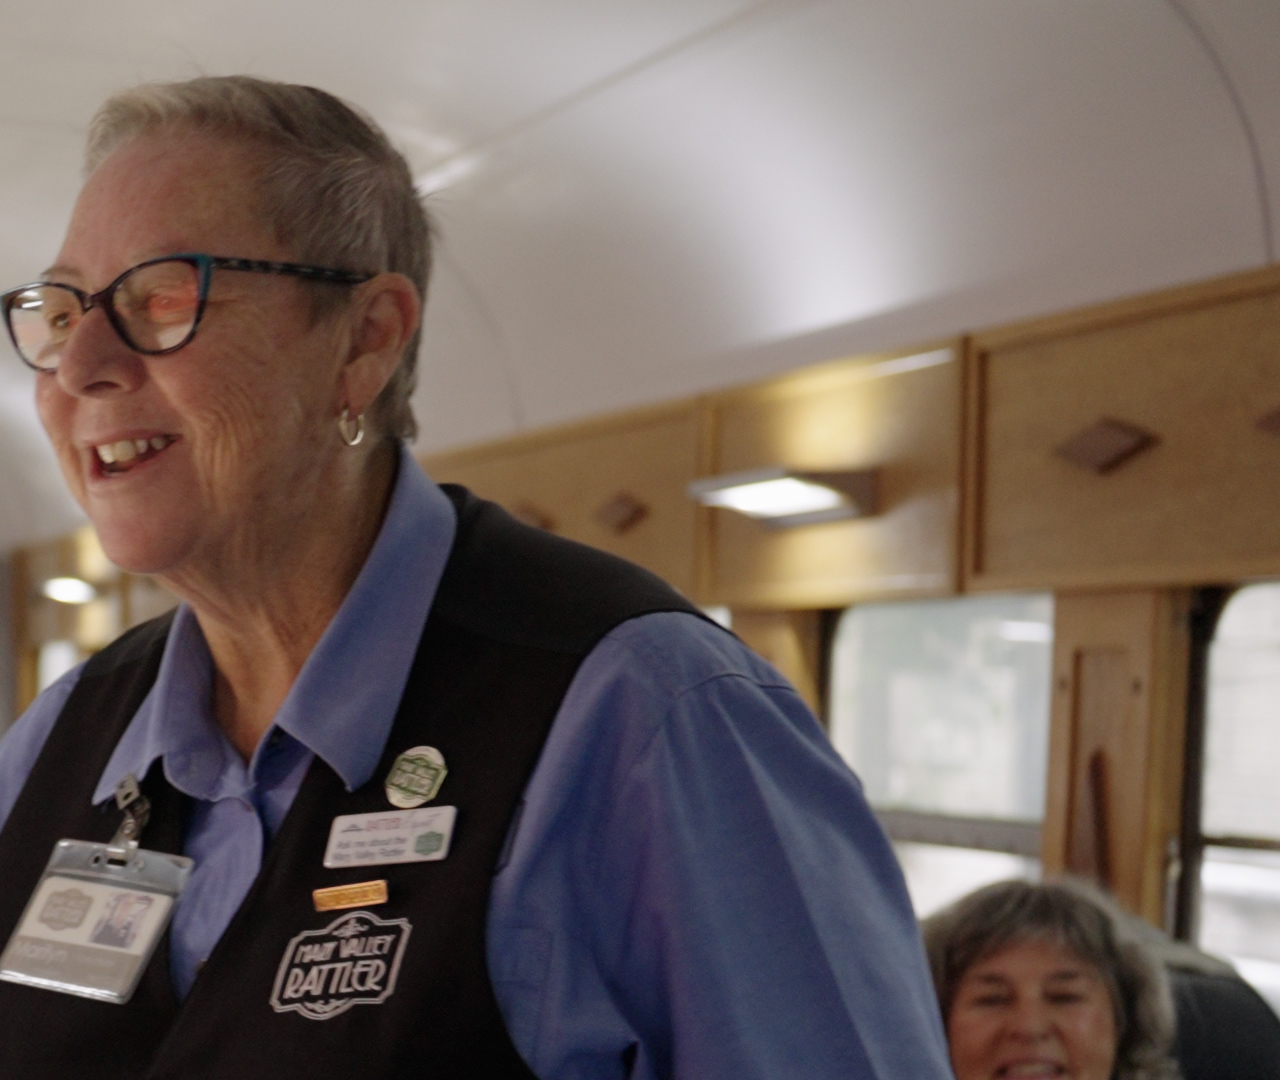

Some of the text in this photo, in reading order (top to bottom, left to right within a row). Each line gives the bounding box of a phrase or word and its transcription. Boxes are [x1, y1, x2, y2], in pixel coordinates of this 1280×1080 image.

[293, 934, 397, 964] MARY VALLEY
[282, 958, 387, 999] RATTLER
